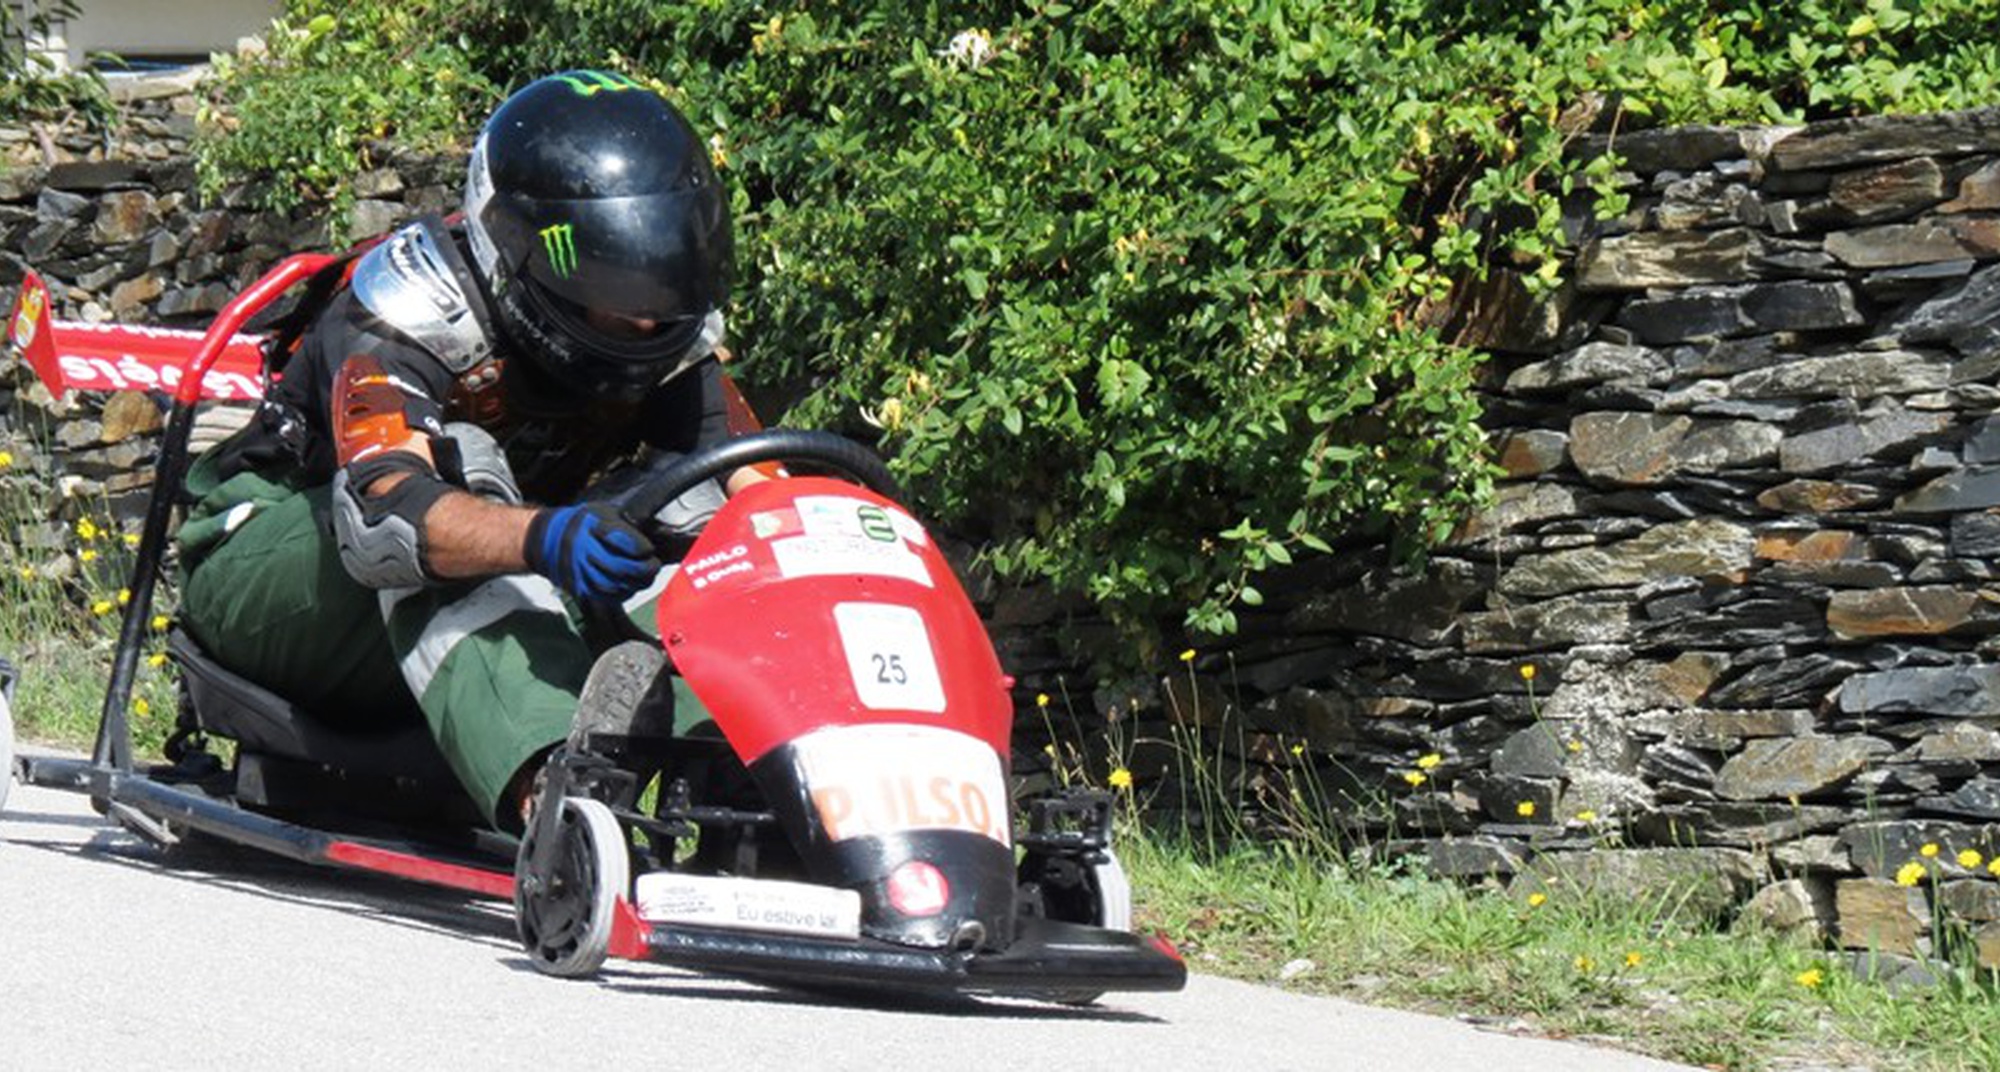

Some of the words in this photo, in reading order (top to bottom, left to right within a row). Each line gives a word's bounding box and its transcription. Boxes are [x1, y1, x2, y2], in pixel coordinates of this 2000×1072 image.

[685, 545, 748, 576] PAULO
[871, 653, 908, 685] 25
[737, 903, 760, 922] Eu
